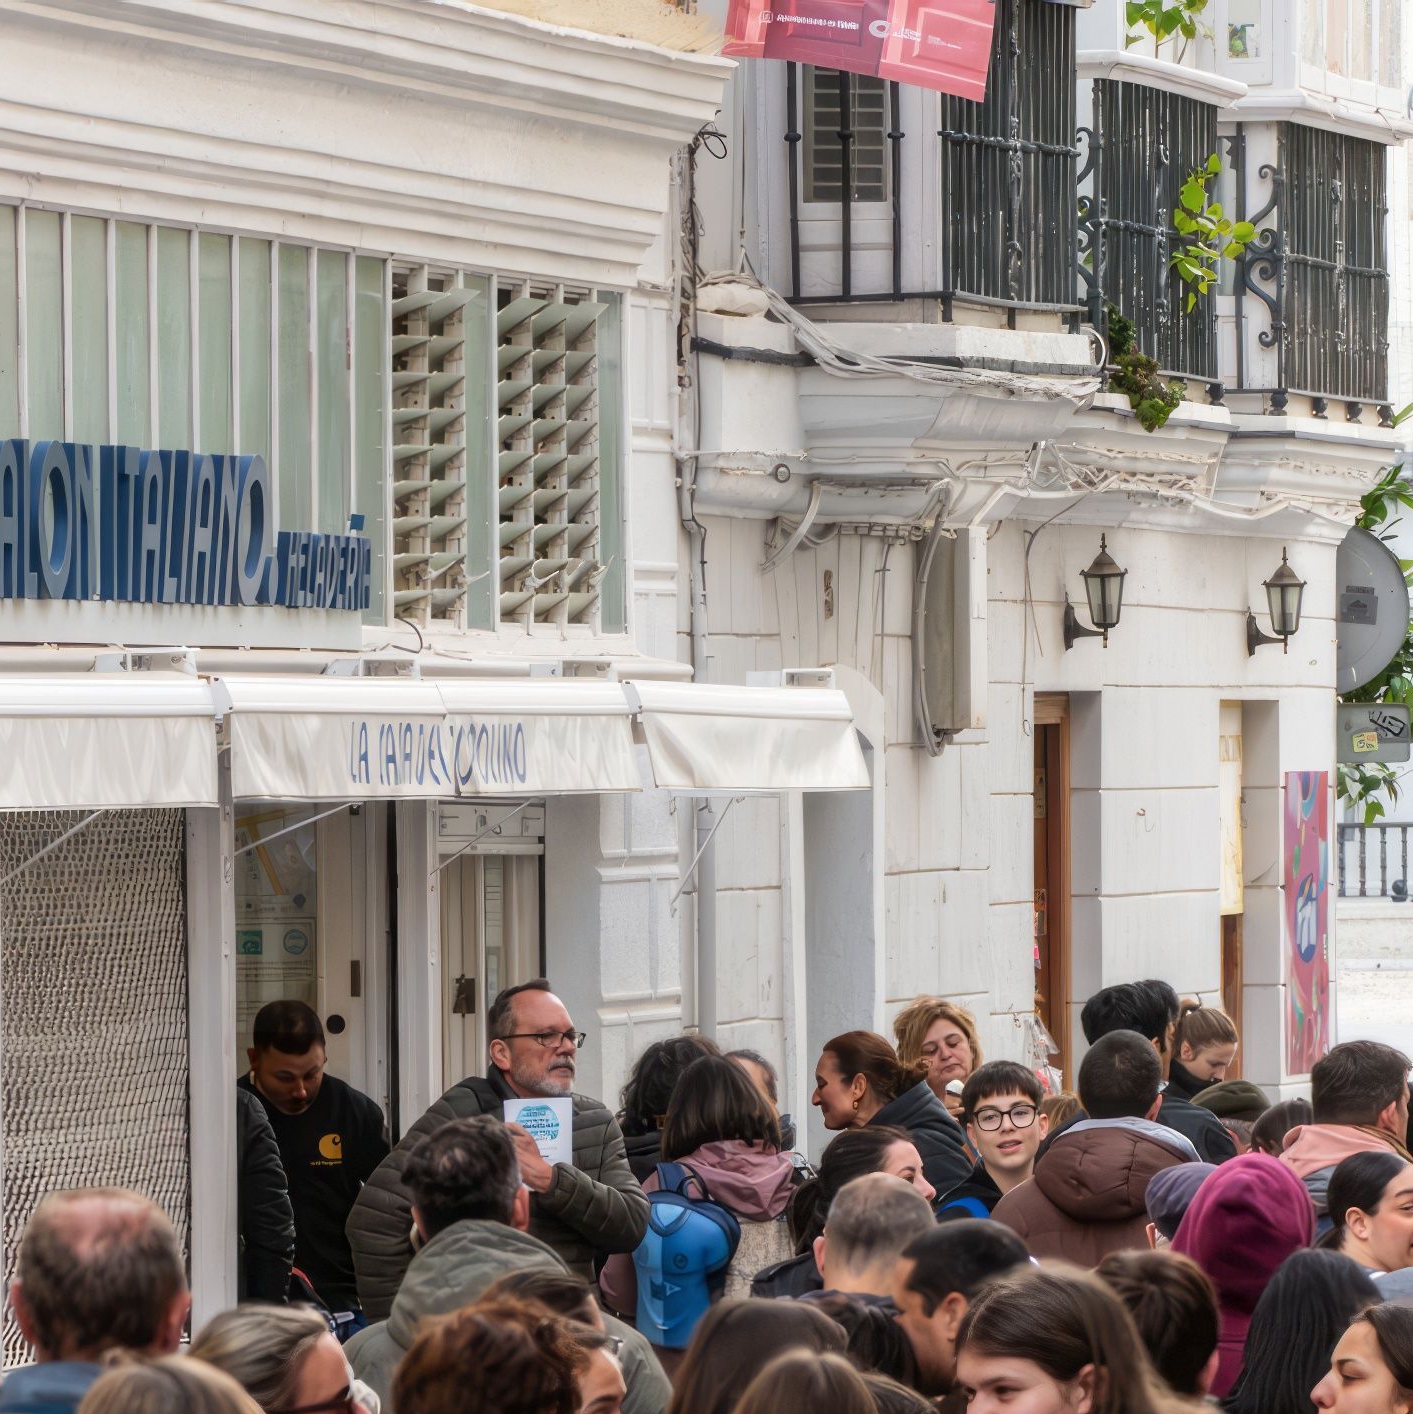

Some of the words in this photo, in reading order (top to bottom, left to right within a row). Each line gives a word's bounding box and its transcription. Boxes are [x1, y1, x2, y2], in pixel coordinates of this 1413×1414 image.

[100, 445, 269, 606] ITALIANO
[351, 721, 370, 785] LA
[379, 722, 413, 786] CAA
